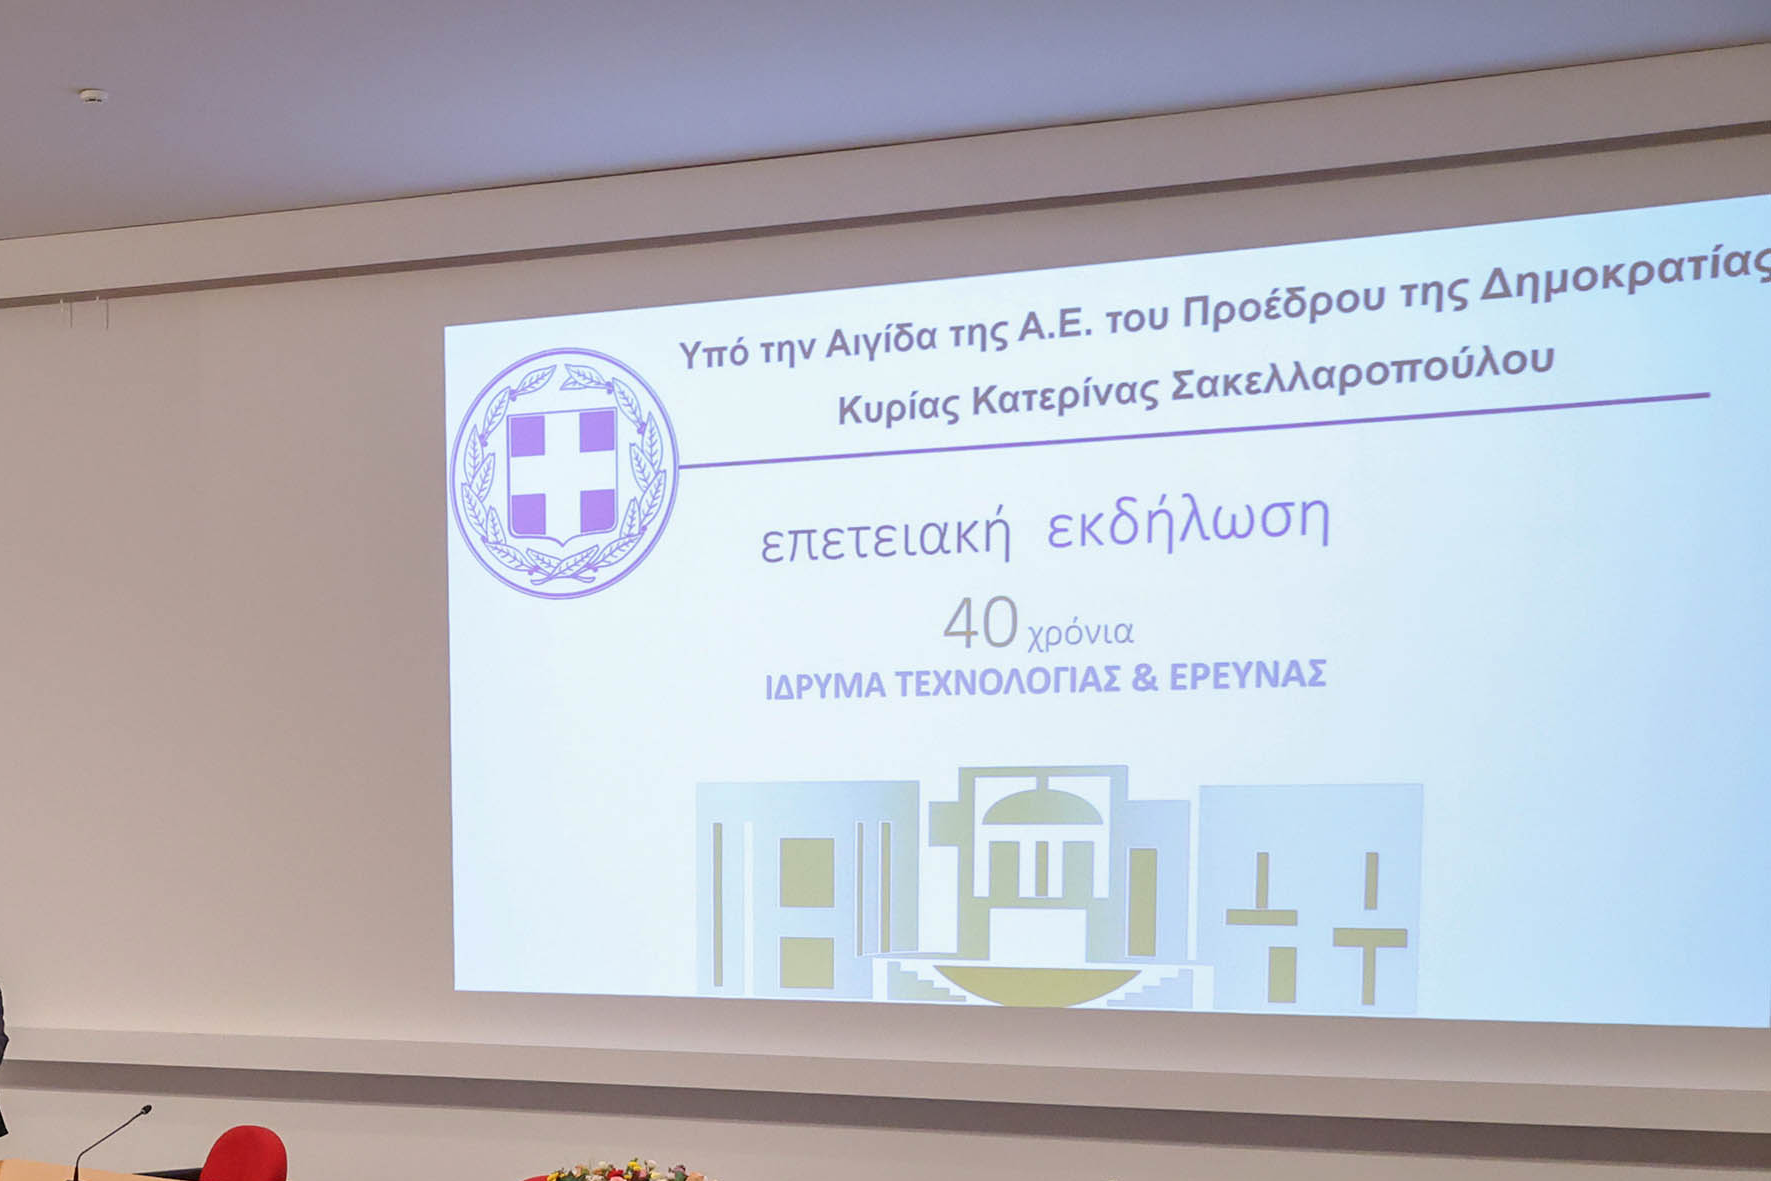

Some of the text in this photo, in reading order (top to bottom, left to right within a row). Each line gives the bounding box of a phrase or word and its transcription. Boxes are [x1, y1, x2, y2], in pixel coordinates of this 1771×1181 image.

[678, 244, 1771, 370] Υπό την Αιγίδα της Α.Ε. του Προέδρου της Δημοκρατίας
[839, 345, 1555, 426] Κυρίας Κατερίνας Σακελλαροπούλου
[761, 492, 1330, 564] επετειακή εκδήλωση
[943, 595, 1135, 654] 40 χρόνια
[766, 658, 1327, 701] ΙΔΡΥΜΑ ΤΕΧΝΟΛΟΓΙΑΣ & ΕΡΕΥΝΑΣ
